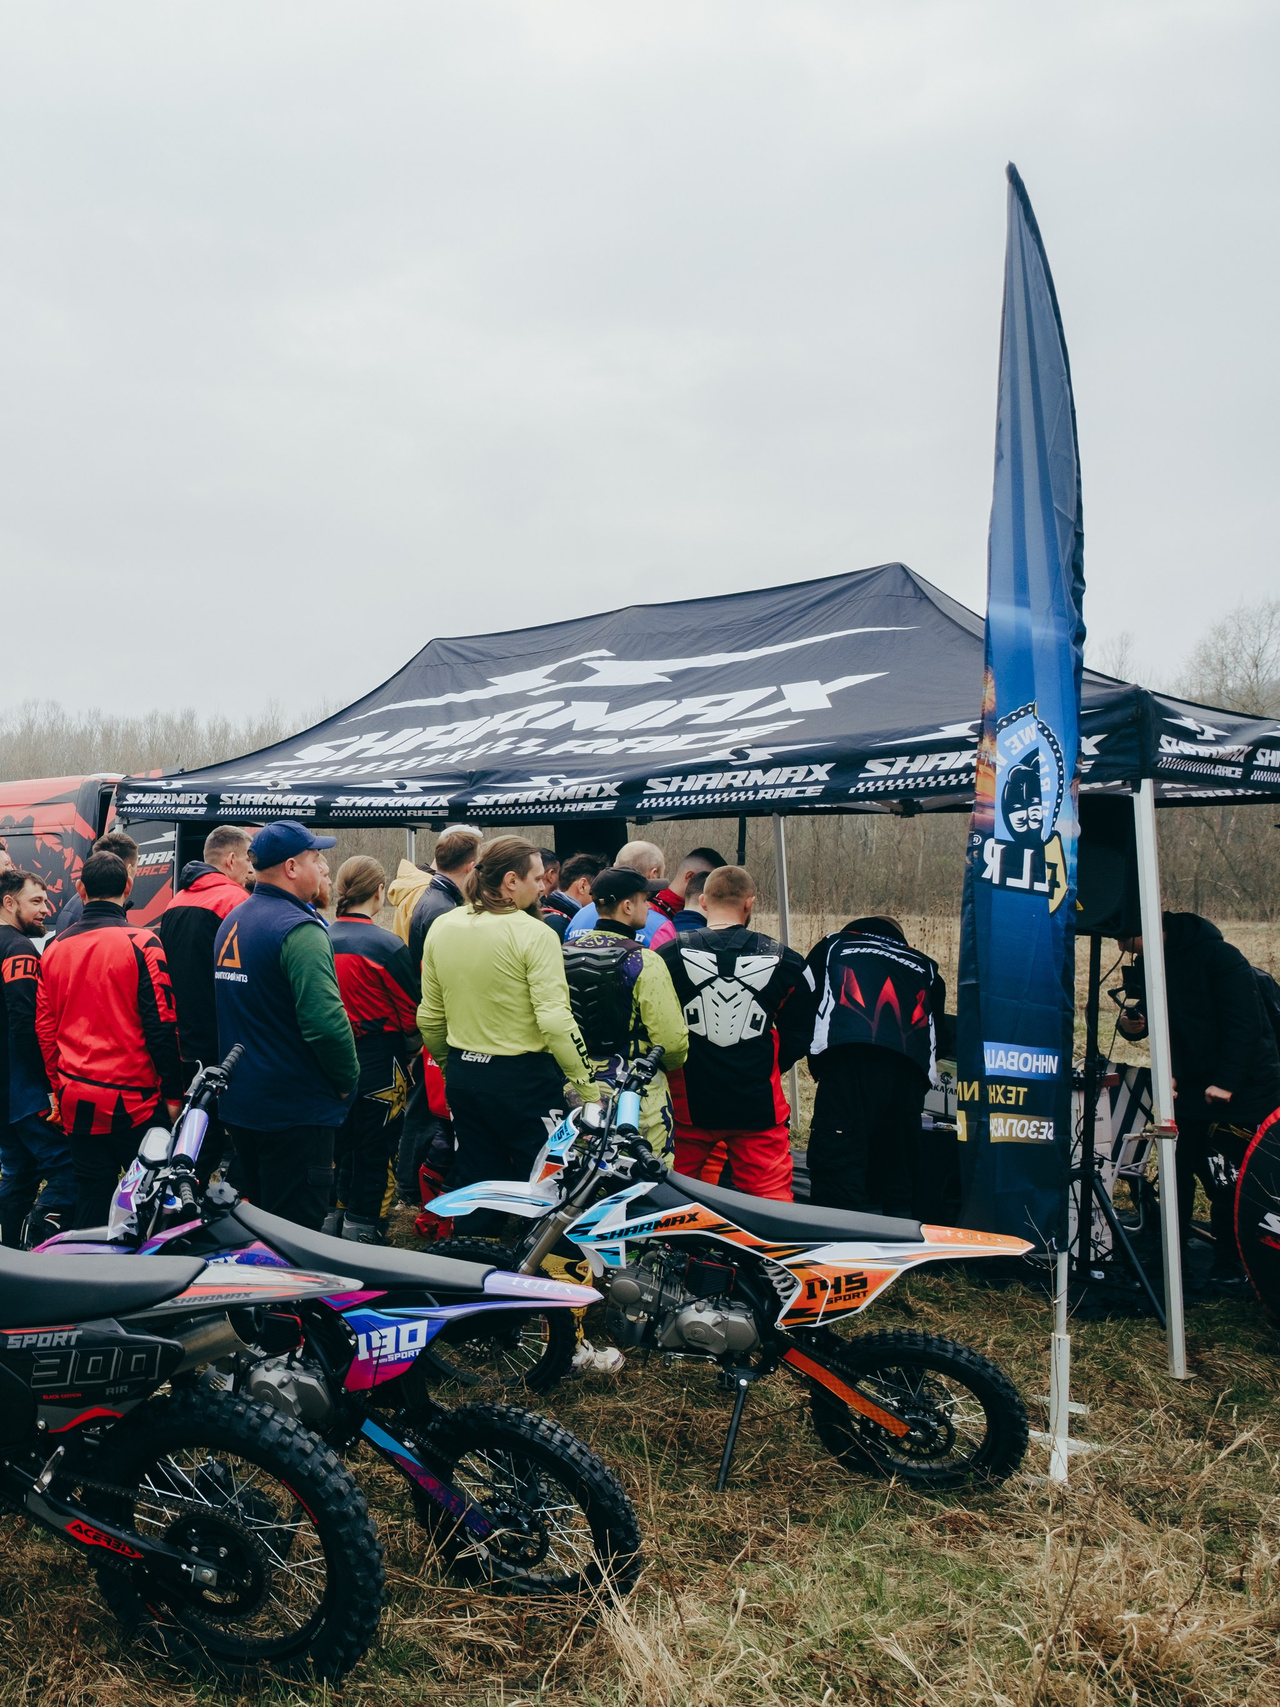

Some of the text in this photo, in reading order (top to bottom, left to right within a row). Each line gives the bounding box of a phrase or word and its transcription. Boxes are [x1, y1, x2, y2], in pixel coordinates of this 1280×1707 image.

[266, 672, 890, 767] SHARMAX
[540, 719, 806, 756] RACE
[1158, 734, 1254, 763] SHARMAX
[643, 763, 837, 794] SHARMAX
[1215, 765, 1243, 779] RACE
[123, 793, 208, 805] SHARMAX
[467, 781, 623, 806] SHARMAX
[755, 785, 825, 800] RACE
[220, 794, 324, 807] SHARMAX
[330, 794, 457, 807] SHARMAX
[562, 800, 618, 812] RACE
[175, 807, 207, 815] RACE
[281, 808, 316, 816] RACE
[406, 809, 449, 817] RACE
[840, 947, 926, 974] SHARMAX
[595, 1211, 699, 1242] SHARMAX
[171, 1292, 254, 1305] SHARMAX
[825, 1290, 869, 1305] SPORT
[7, 1330, 83, 1349] SPORT
[357, 1319, 428, 1362] 190
[387, 1350, 421, 1361] SPORT
[31, 1344, 161, 1388] 300
